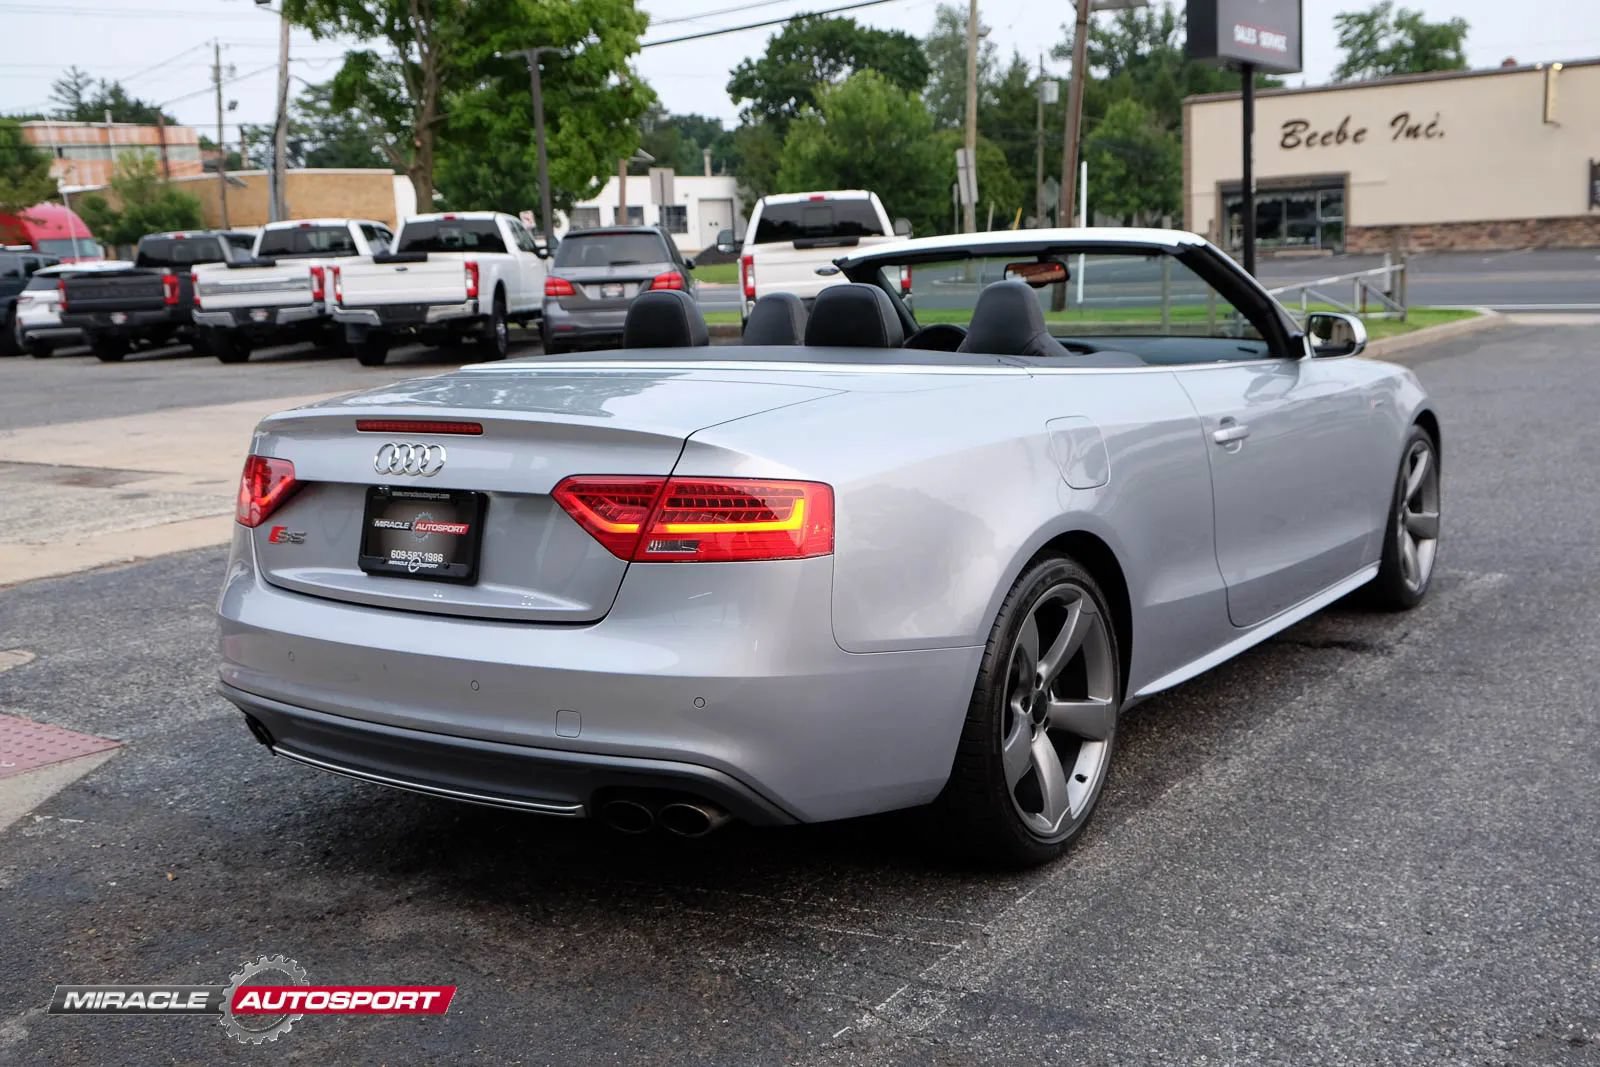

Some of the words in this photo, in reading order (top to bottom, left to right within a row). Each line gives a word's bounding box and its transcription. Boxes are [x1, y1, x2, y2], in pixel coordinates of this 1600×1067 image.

[1233, 24, 1257, 45] SALES
[1280, 115, 1368, 149] Beebe
[374, 520, 410, 529] MIRACLE
[415, 523, 465, 533] AUTOSPORT
